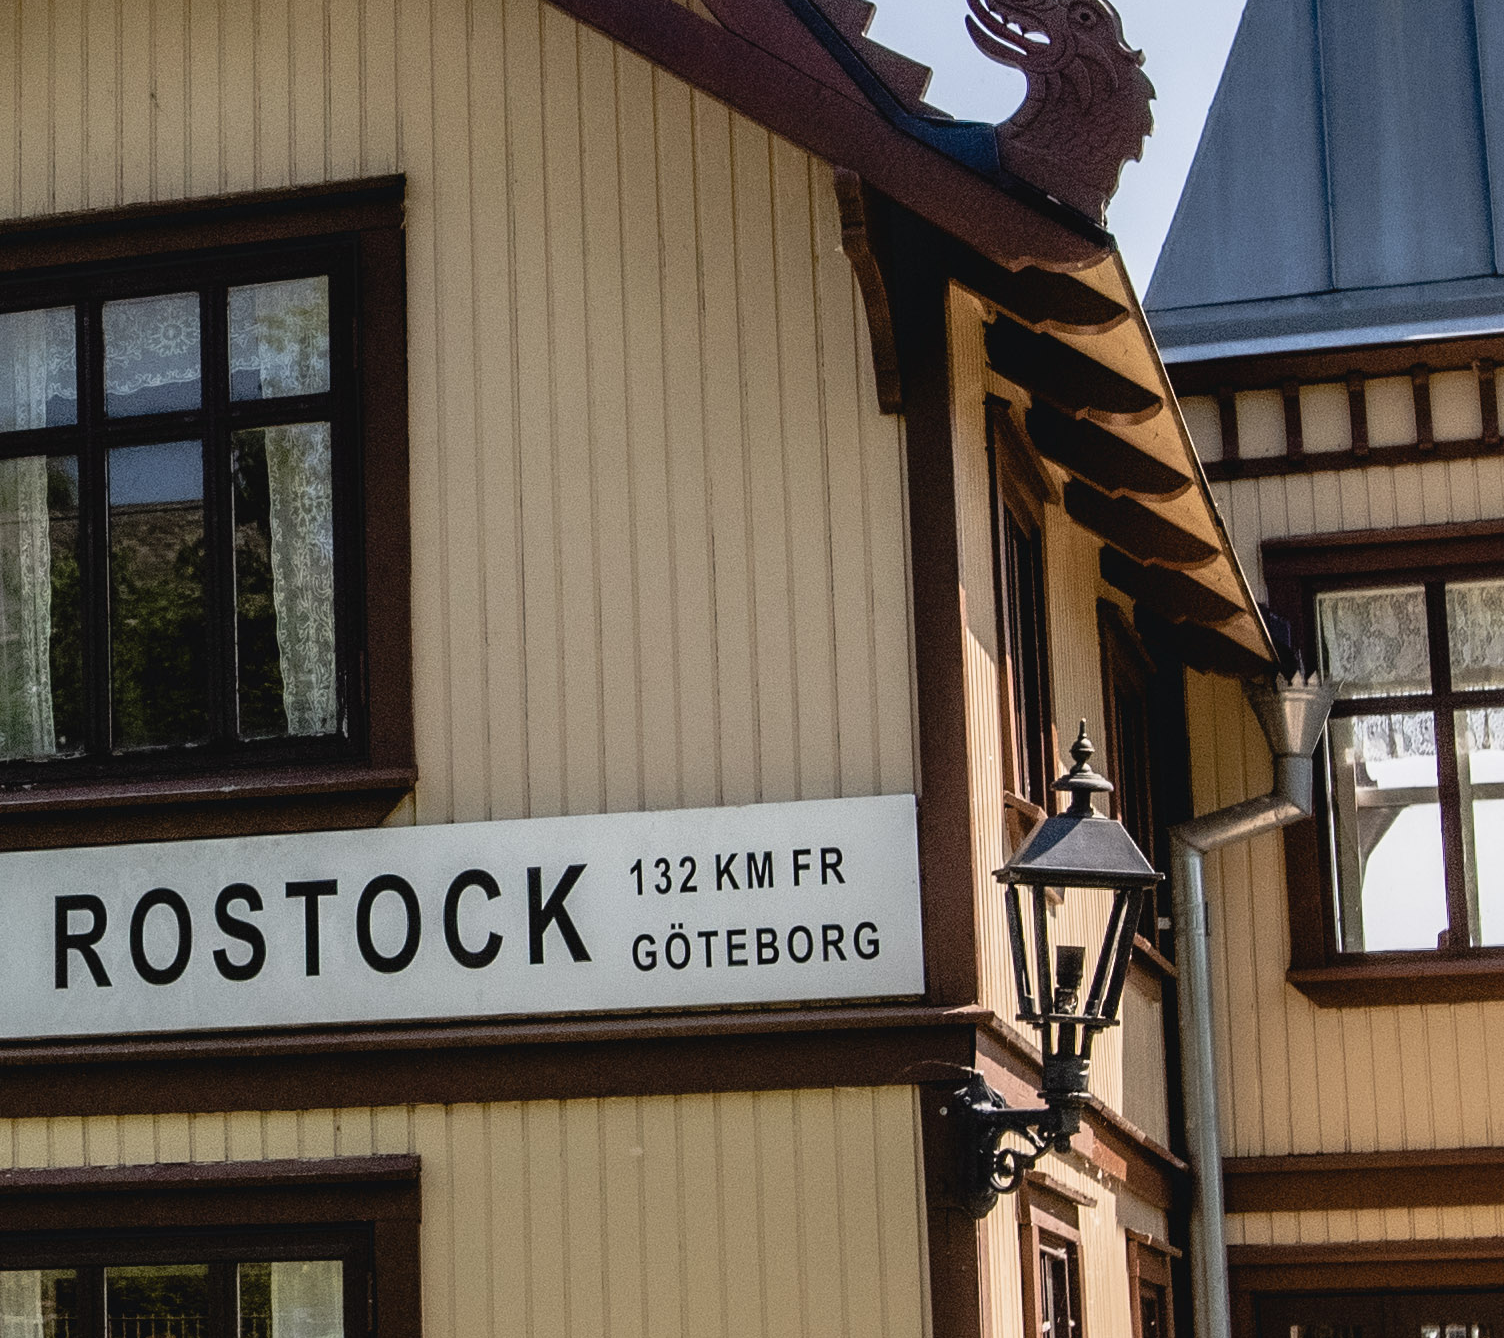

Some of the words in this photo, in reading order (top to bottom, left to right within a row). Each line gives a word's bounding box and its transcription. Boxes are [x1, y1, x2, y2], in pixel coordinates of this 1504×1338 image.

[630, 857, 698, 896] 132
[715, 850, 774, 891] KM
[792, 847, 846, 887] FR
[54, 863, 592, 990] ROSTOCK
[631, 921, 880, 972] GÖTEBORG
